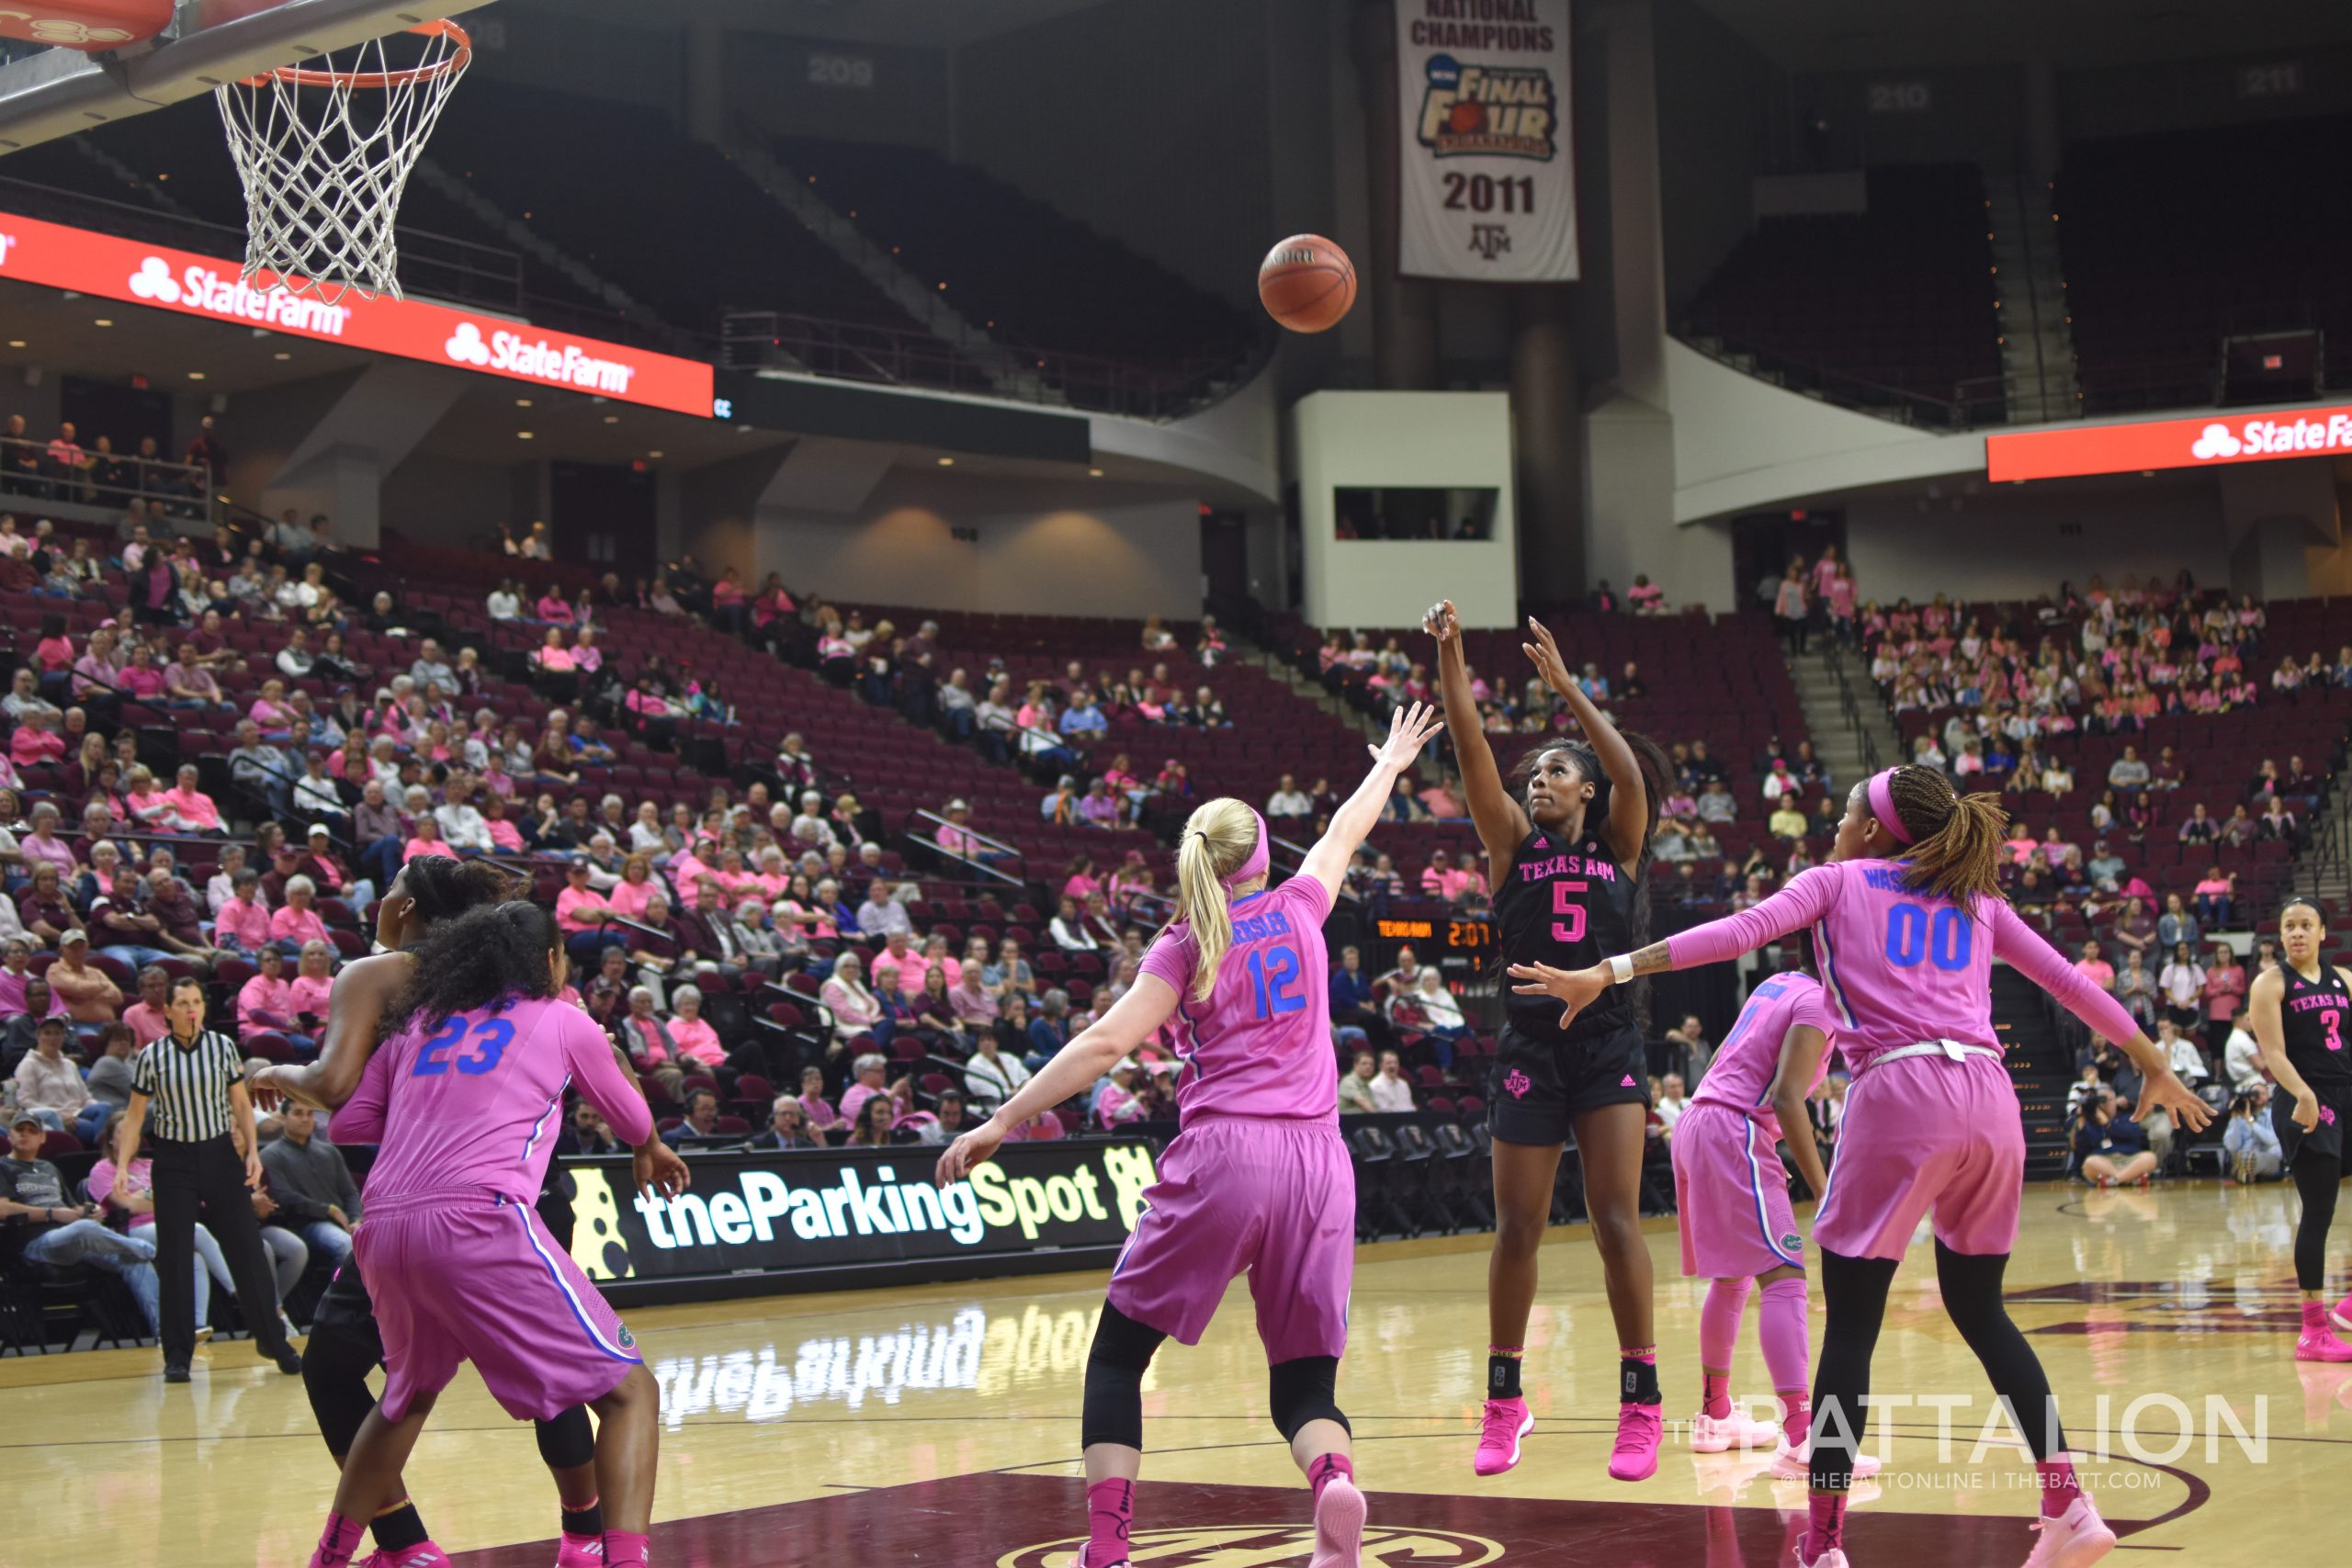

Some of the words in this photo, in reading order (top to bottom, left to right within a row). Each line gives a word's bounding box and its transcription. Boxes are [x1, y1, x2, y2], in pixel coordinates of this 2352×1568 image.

[1427, 0, 1538, 22] NATIONAL
[1412, 18, 1554, 52] CHAMPIONS
[808, 56, 873, 86] 209
[1458, 68, 1549, 105] FINAL
[2245, 66, 2296, 94] 211
[1871, 85, 1928, 110] 210
[1442, 172, 1535, 214] 2011
[1519, 854, 1580, 882] TEXAS
[1585, 858, 1615, 882] A&M
[1551, 881, 1589, 942] 5
[1448, 922, 1489, 946] 2:07
[1885, 903, 1973, 972] 00
[1248, 945, 1307, 1019] 12
[2290, 994, 2334, 1013] TEXAS
[412, 1016, 515, 1076] 23
[2320, 1009, 2342, 1051] 3
